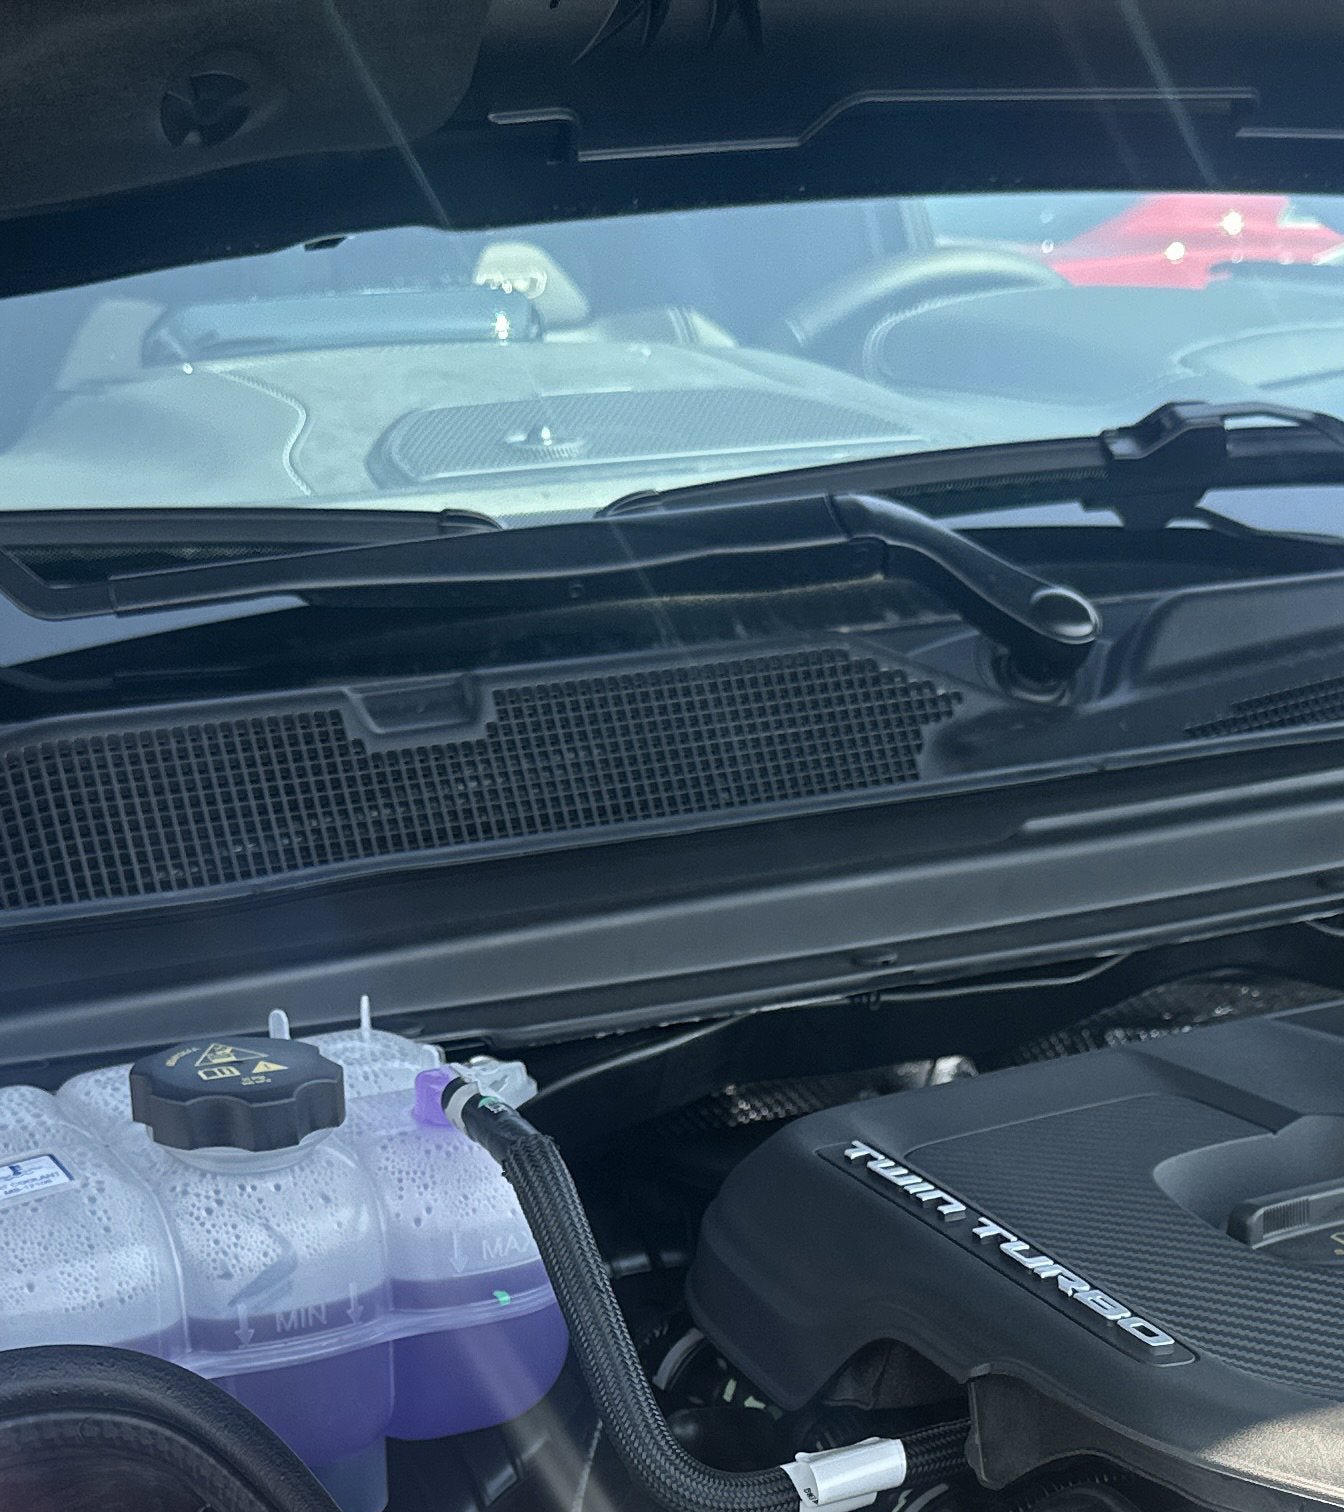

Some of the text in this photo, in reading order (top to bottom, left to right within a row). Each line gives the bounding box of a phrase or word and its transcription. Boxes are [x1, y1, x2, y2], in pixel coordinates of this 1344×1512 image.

[482, 1231, 535, 1261] MAX
[844, 1140, 1176, 1347] TWIN TURBO
[275, 1302, 328, 1333] MIN
